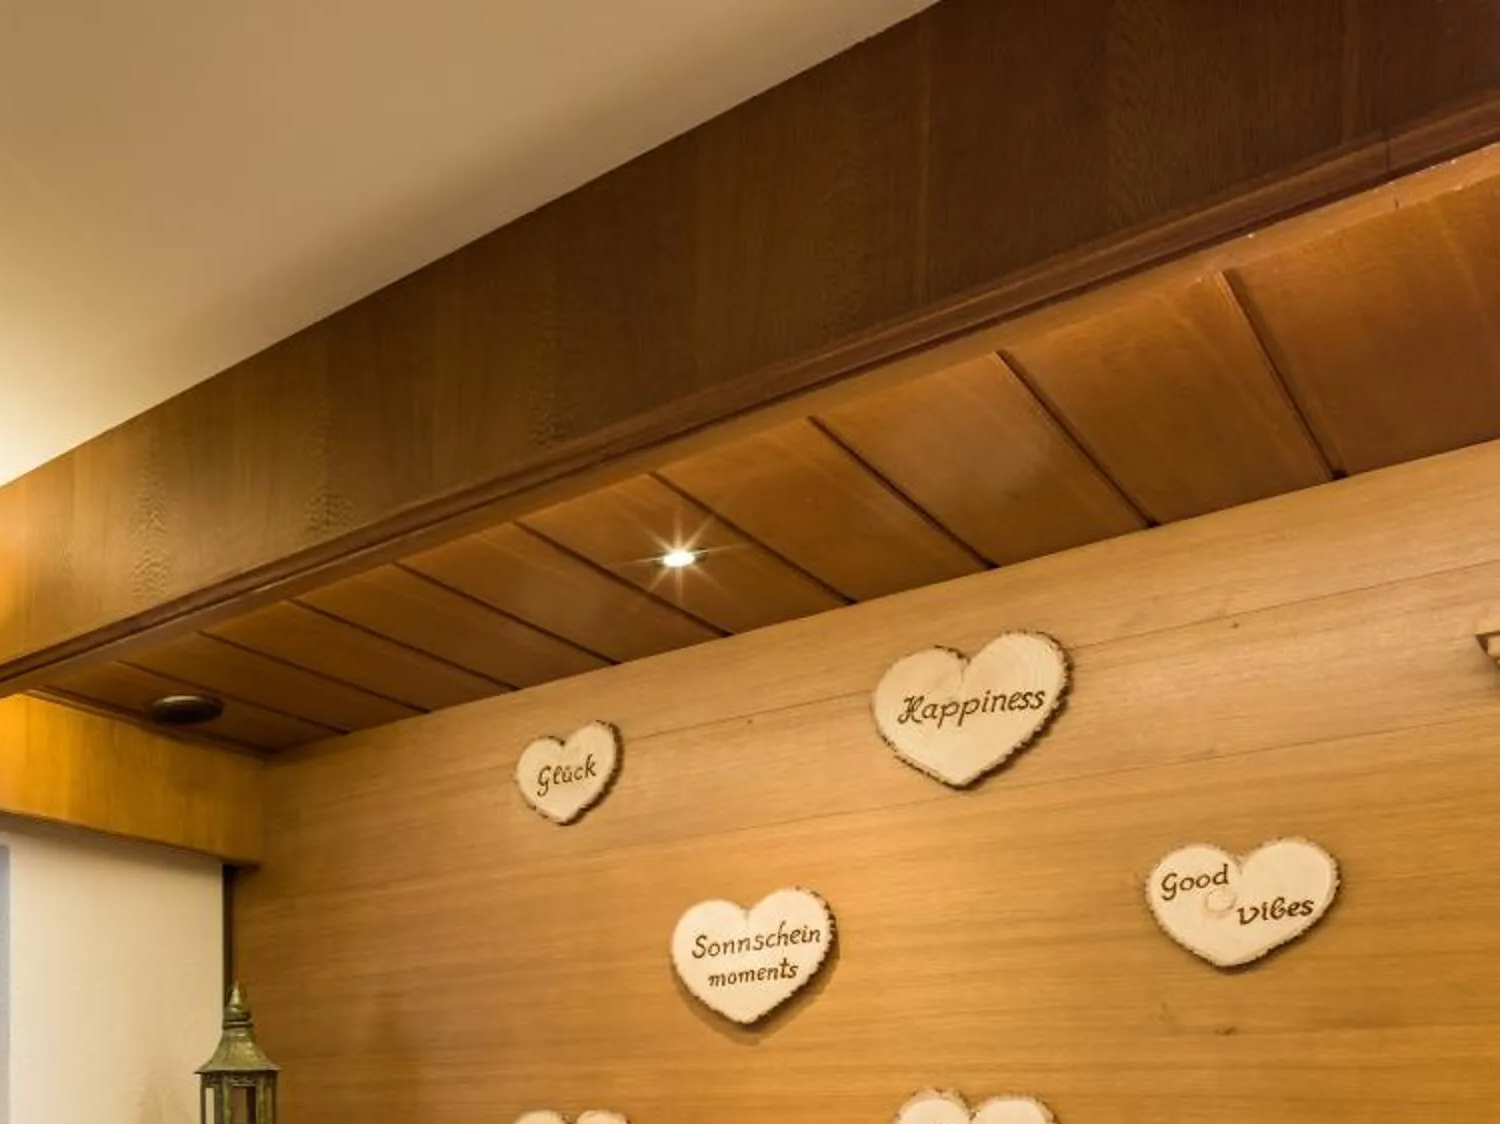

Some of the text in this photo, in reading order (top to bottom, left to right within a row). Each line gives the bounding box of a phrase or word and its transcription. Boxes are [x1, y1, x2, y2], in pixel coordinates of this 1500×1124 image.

[897, 689, 1047, 730] Happiness
[536, 753, 597, 797] Glück
[1161, 863, 1229, 901] Good
[1236, 896, 1315, 925] vibes
[691, 920, 822, 959] Sonnschein
[707, 957, 800, 987] moments
